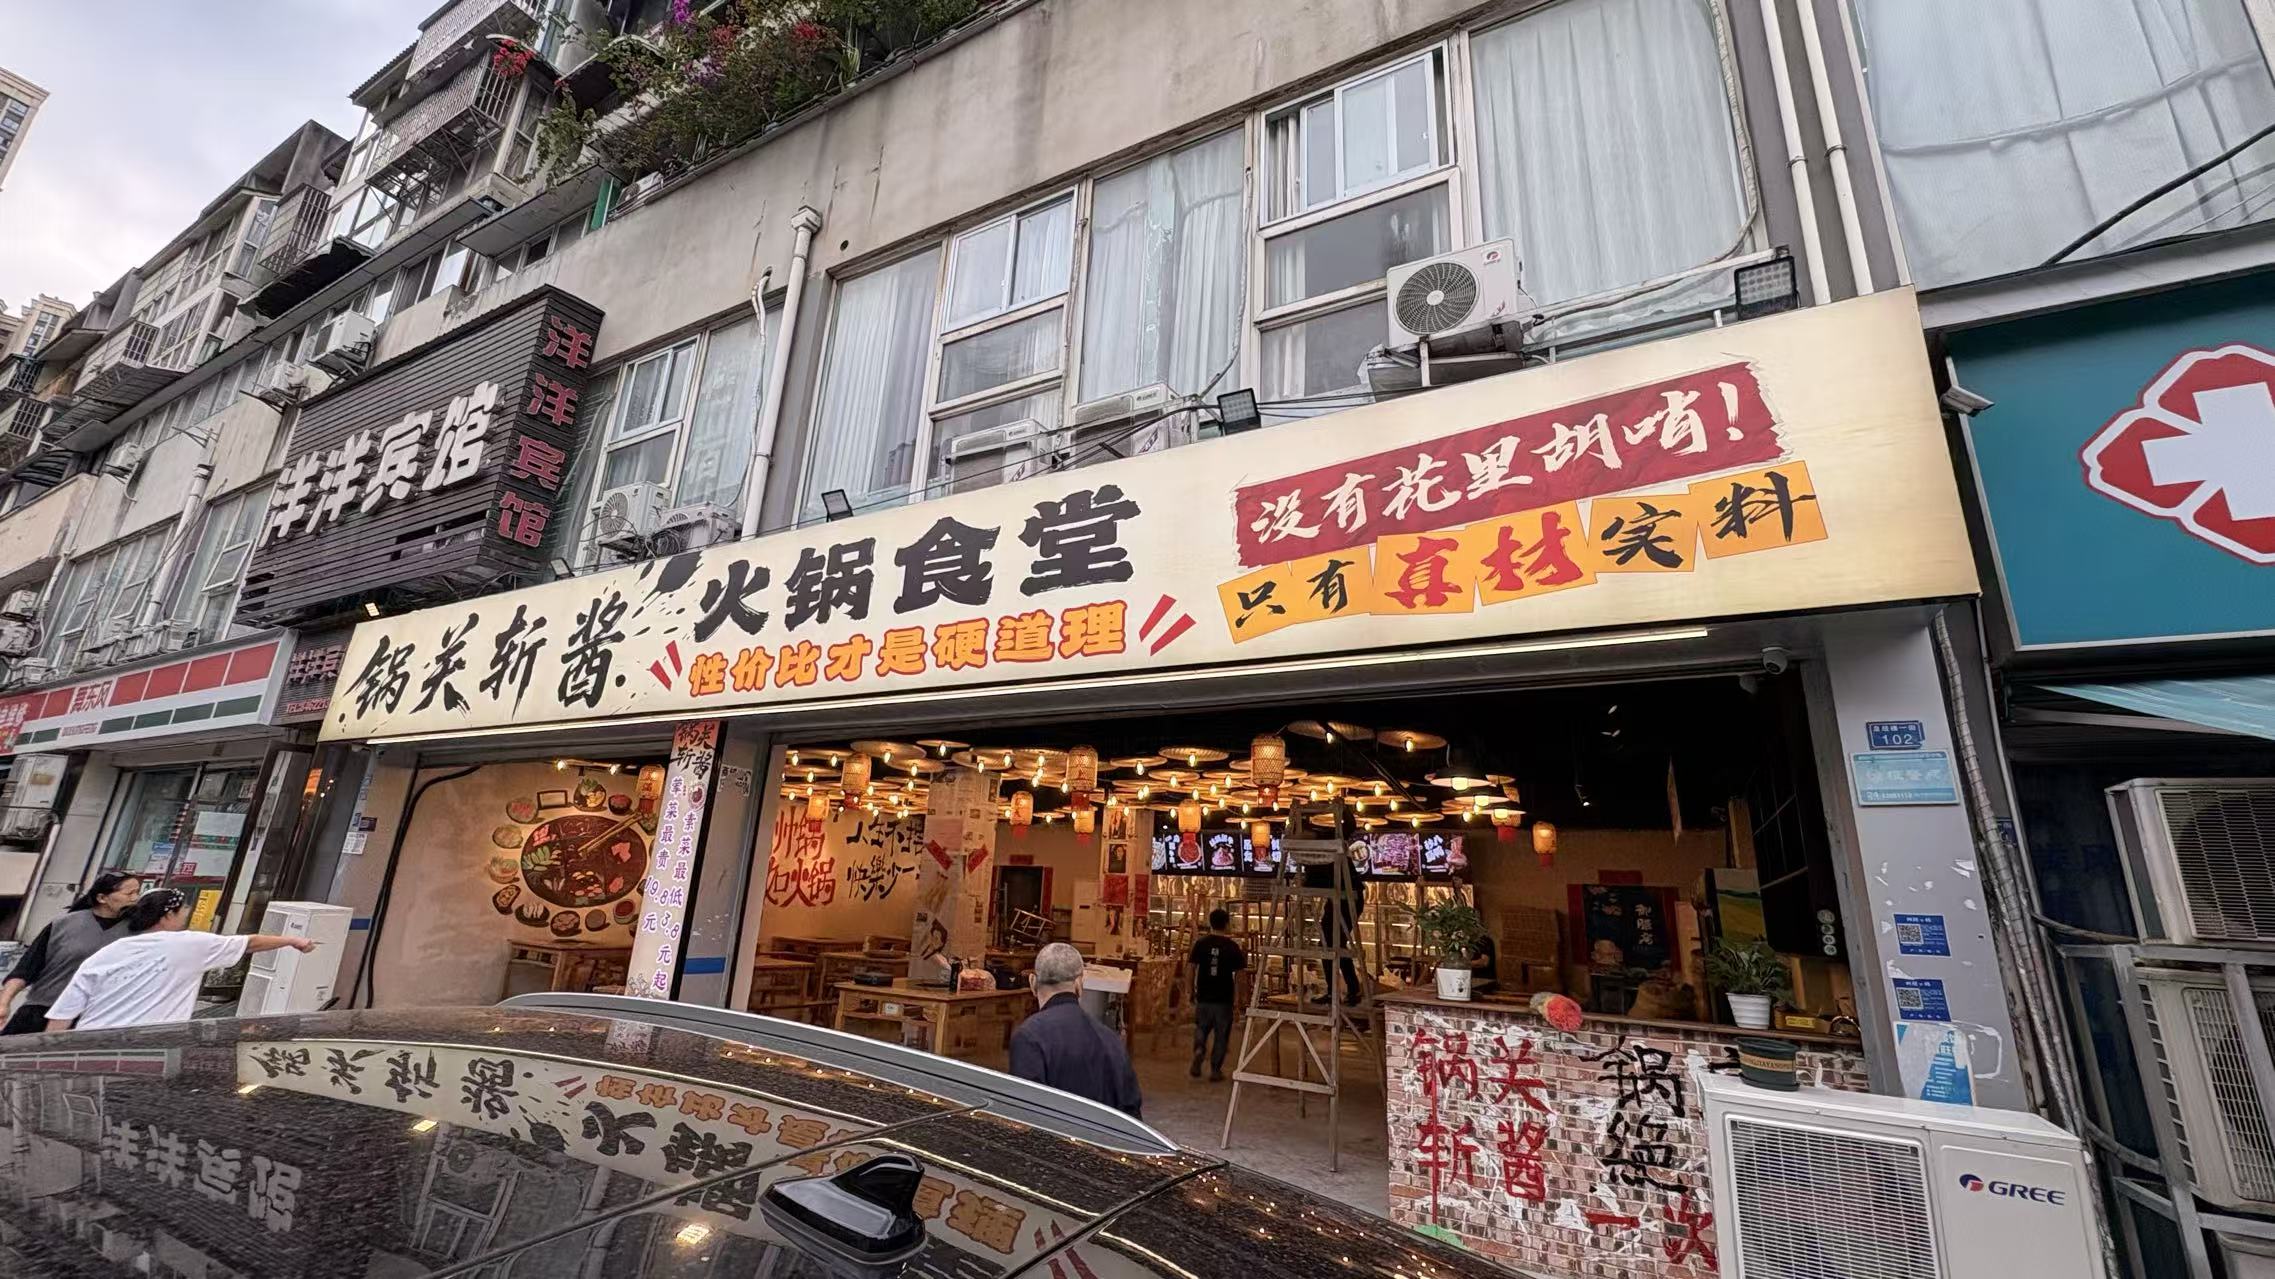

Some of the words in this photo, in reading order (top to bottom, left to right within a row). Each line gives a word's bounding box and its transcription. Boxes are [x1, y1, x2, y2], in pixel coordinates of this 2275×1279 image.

[257, 381, 499, 548] 洋洋宾馆
[499, 315, 593, 548] 洋洋宾馆
[694, 485, 1142, 643] 火锅食堂
[1235, 471, 1816, 628] 只有真材实料
[344, 591, 628, 720] 锅关斩酱
[689, 601, 1128, 698] 性价比才是硬道理
[1882, 733, 1913, 745] 102
[1988, 1180, 2066, 1206] GREE
